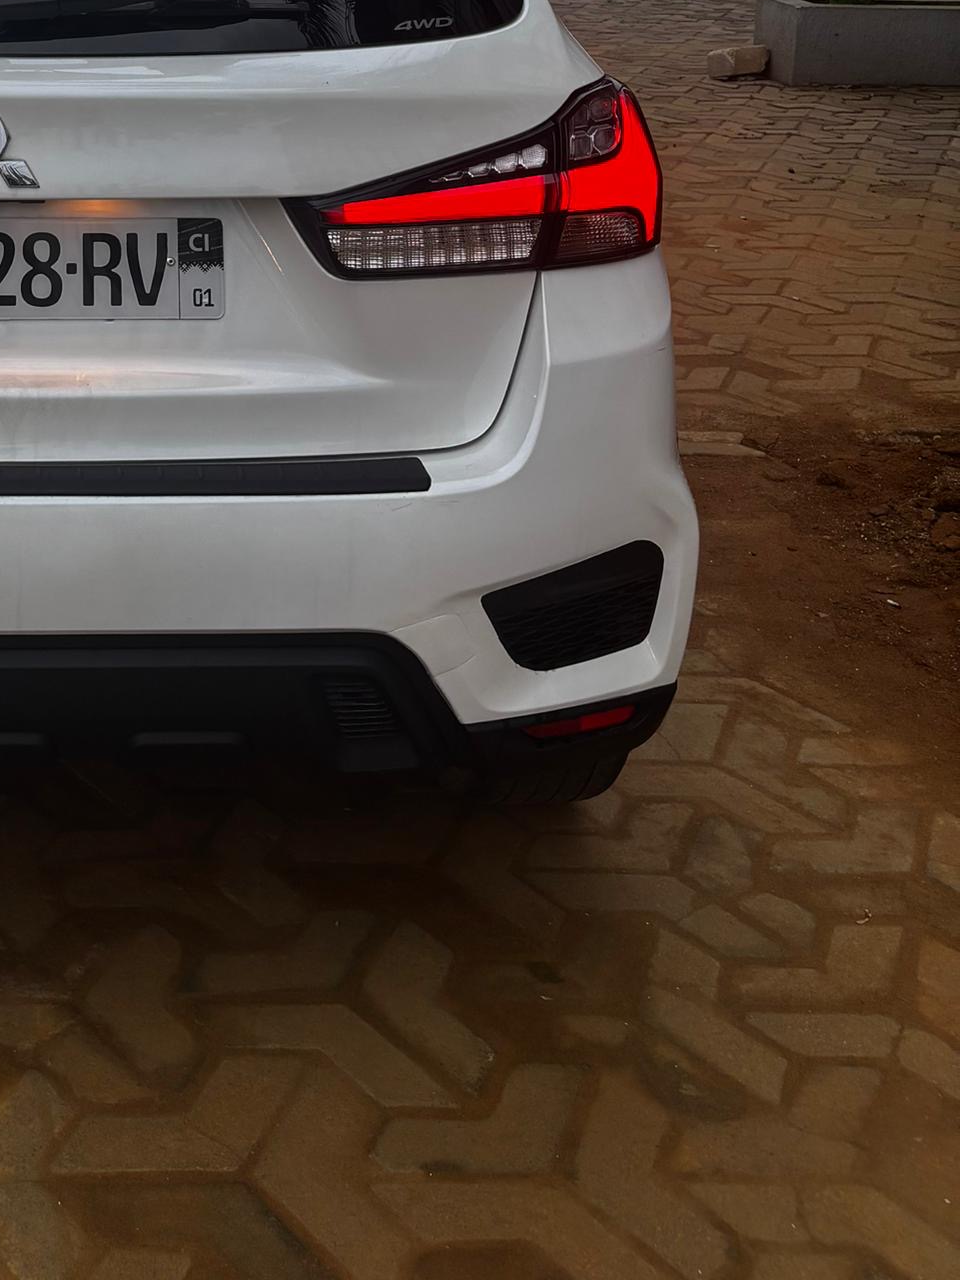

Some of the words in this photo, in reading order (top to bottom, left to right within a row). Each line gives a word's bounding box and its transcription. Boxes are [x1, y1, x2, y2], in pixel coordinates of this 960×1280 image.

[393, 17, 454, 31] 4WD
[189, 233, 210, 253] CI
[192, 288, 215, 308] 01
